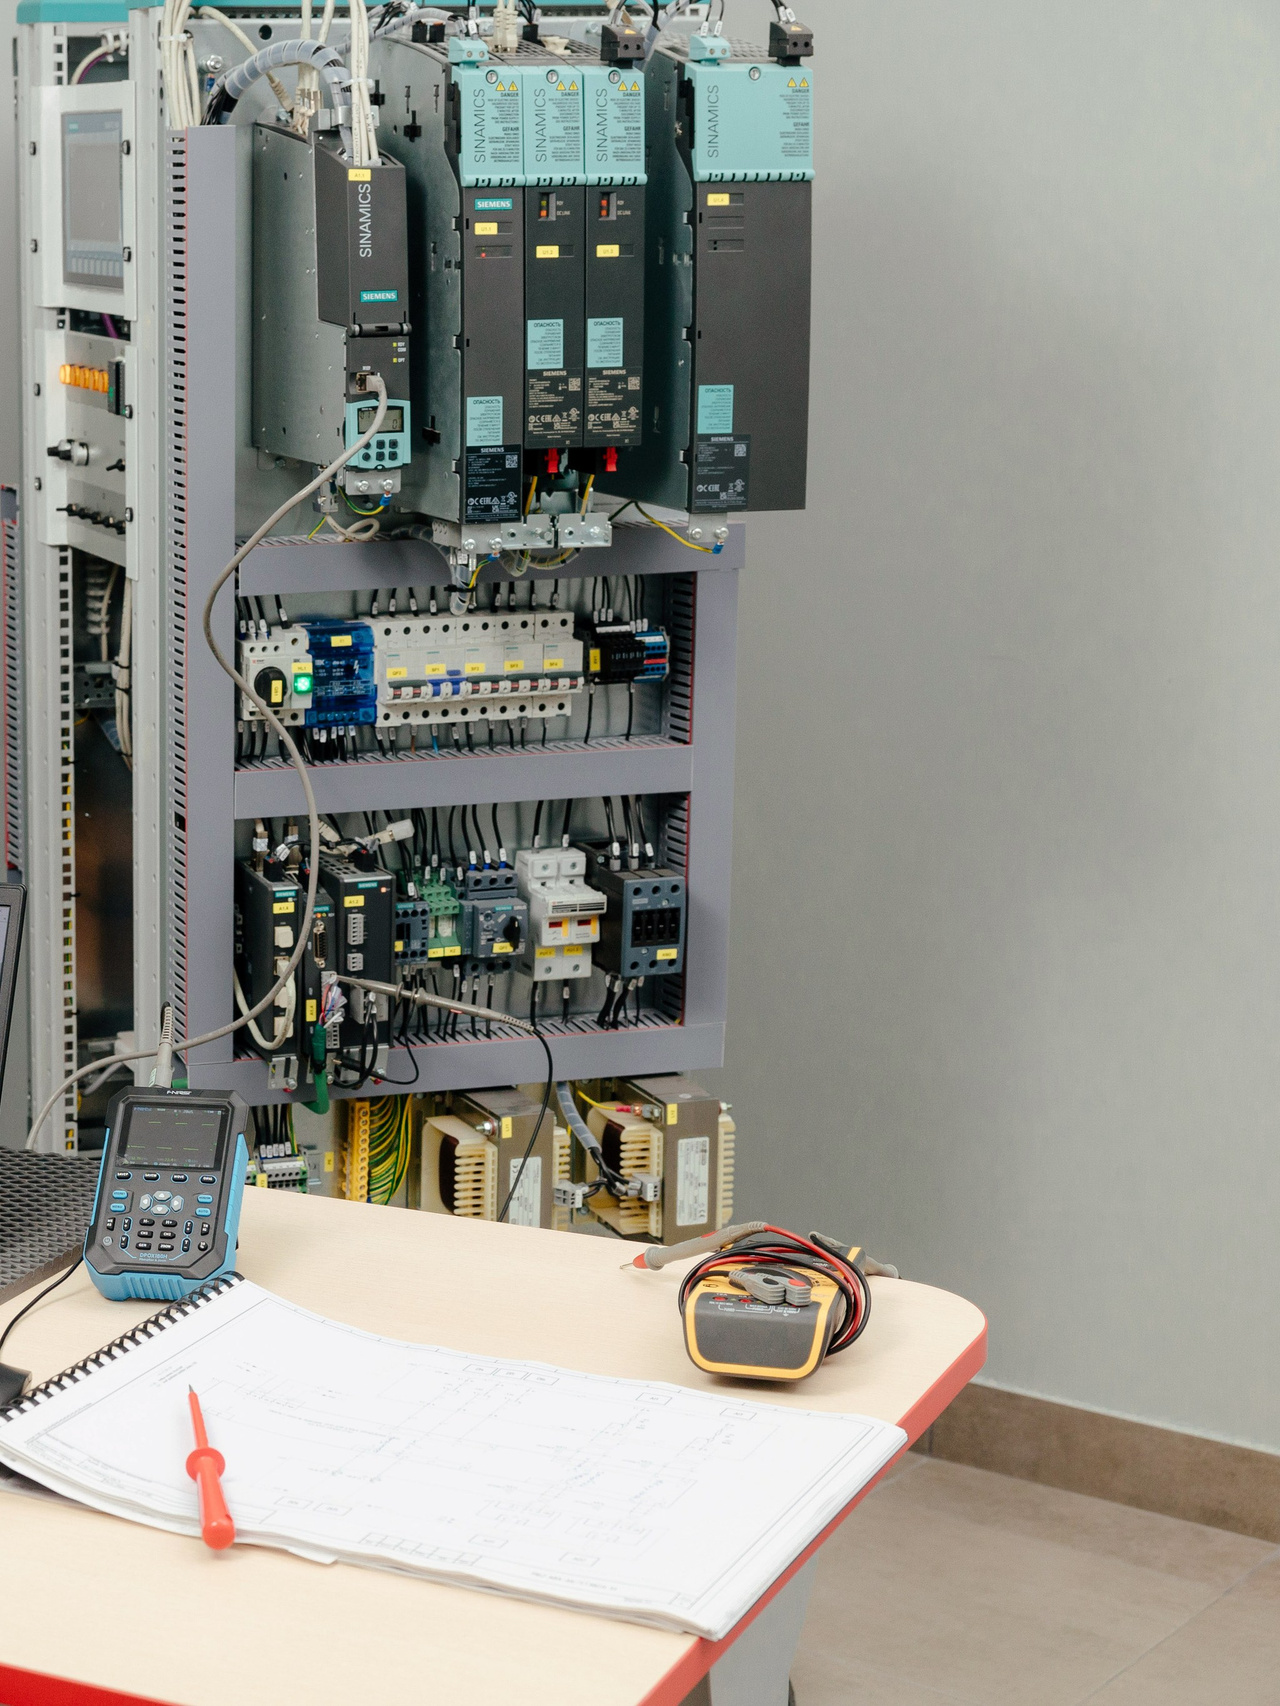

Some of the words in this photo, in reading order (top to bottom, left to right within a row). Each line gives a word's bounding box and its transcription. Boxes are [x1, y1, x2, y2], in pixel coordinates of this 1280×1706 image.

[473, 88, 486, 163] SINAMICS
[534, 88, 547, 162] SINAMICS
[596, 88, 608, 162] SINAMICS
[708, 85, 719, 158] SINAMICS
[358, 183, 372, 258] SINAMICS
